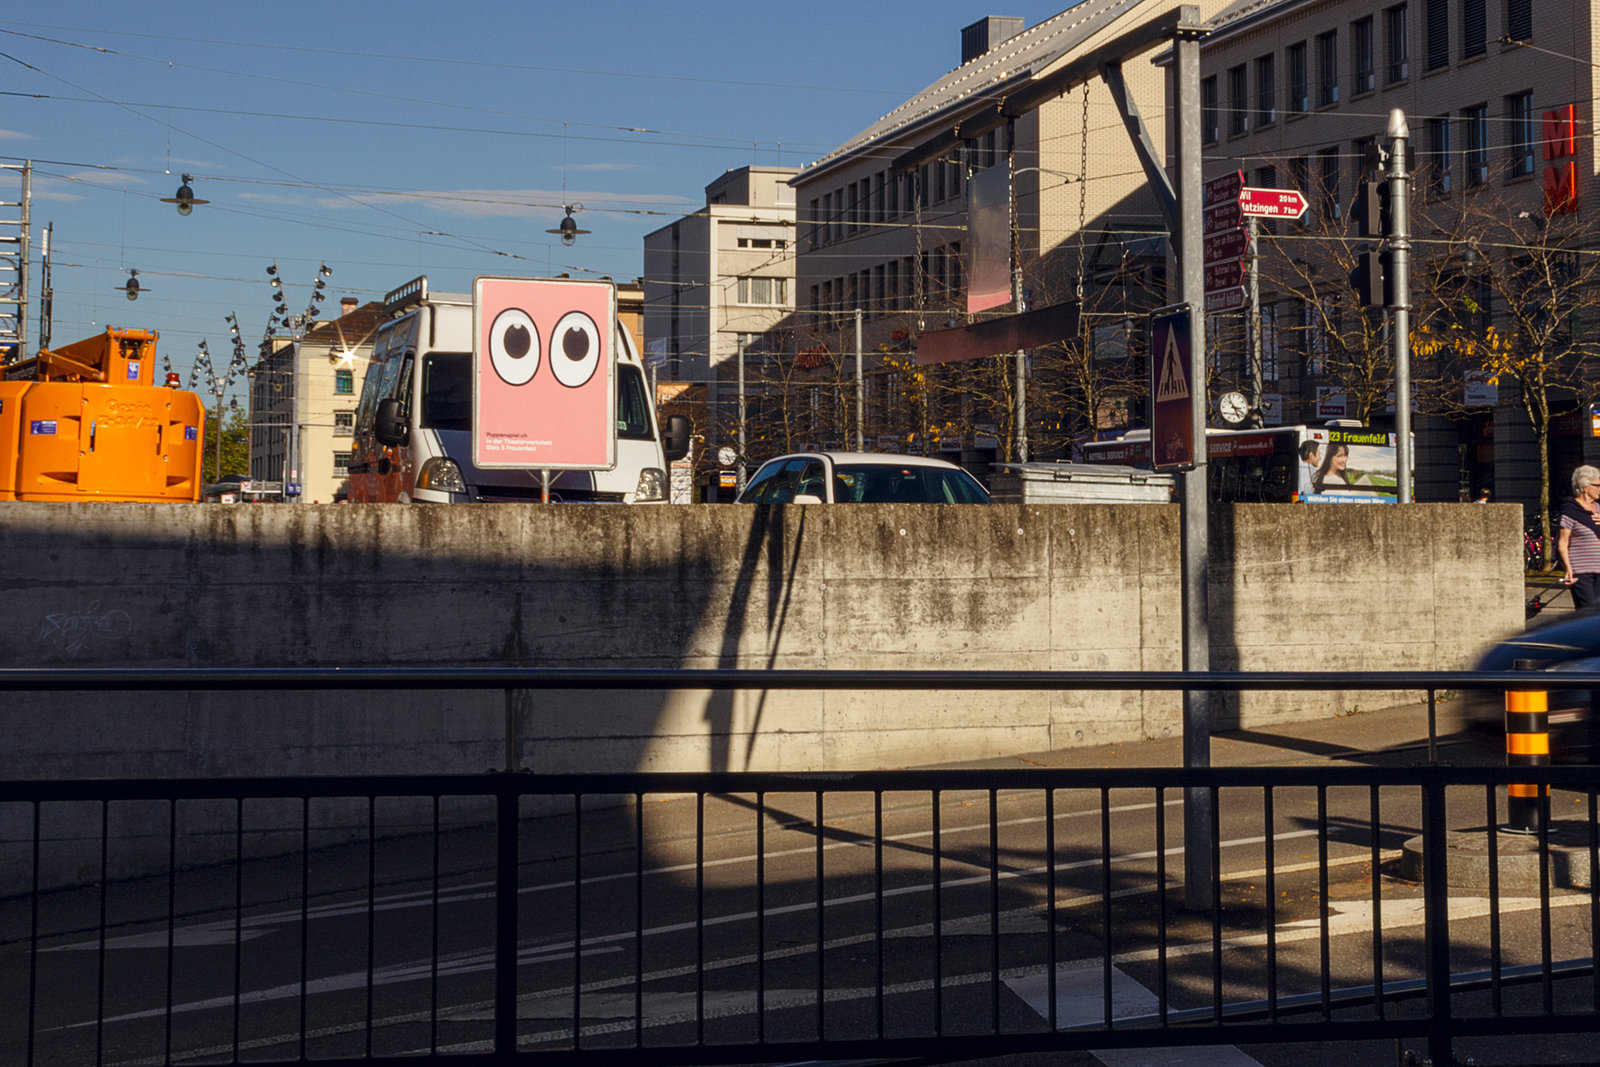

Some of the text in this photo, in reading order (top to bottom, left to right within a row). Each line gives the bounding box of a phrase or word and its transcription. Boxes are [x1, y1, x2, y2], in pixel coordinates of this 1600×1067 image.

[1343, 432, 1386, 444] Frauenfeld
[1209, 442, 1232, 454] SERVICE
[1107, 450, 1125, 460] SERVICE
